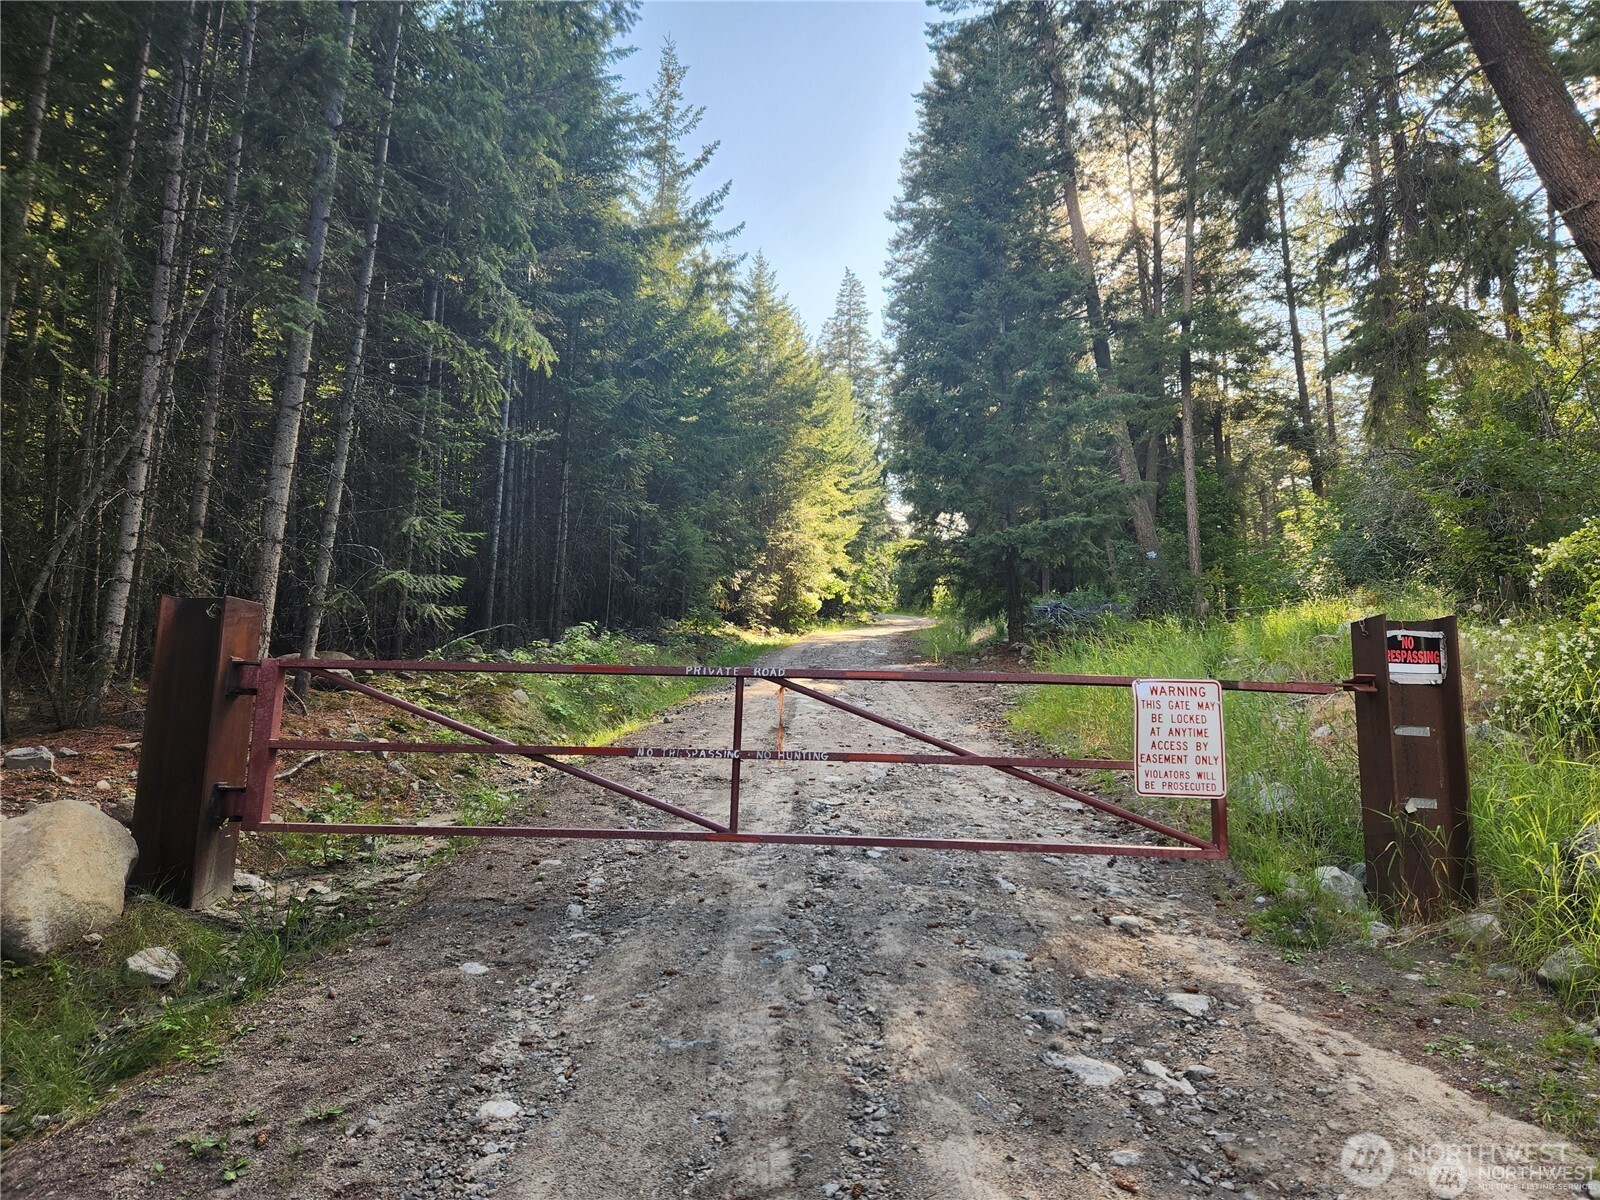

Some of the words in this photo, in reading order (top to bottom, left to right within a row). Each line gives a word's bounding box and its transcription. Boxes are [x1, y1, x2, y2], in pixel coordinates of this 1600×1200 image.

[1401, 636, 1415, 649] NO
[685, 665, 740, 676] PRIVATE
[753, 667, 786, 677] ROAD
[1149, 686, 1206, 697] WARNING
[1141, 700, 1162, 710] THIS
[1168, 701, 1190, 711] GATE
[1197, 702, 1216, 711] MAY
[1151, 713, 1163, 723] BE
[1171, 714, 1207, 724] LOCKED
[1150, 727, 1161, 737] AT
[1168, 728, 1209, 738] ANYTIME
[1151, 740, 1188, 751] ACCESS
[1195, 741, 1209, 751] BY
[637, 747, 654, 757] NO
[756, 750, 771, 759] NO
[778, 750, 829, 761] HUNTING
[1140, 754, 1188, 764] EASEMENT
[1195, 755, 1219, 765] ONLY
[1144, 770, 1190, 780] VIOLATORS
[1196, 771, 1216, 780] WILL
[1144, 781, 1156, 790] BE
[1162, 782, 1217, 792] PROSECUTED
